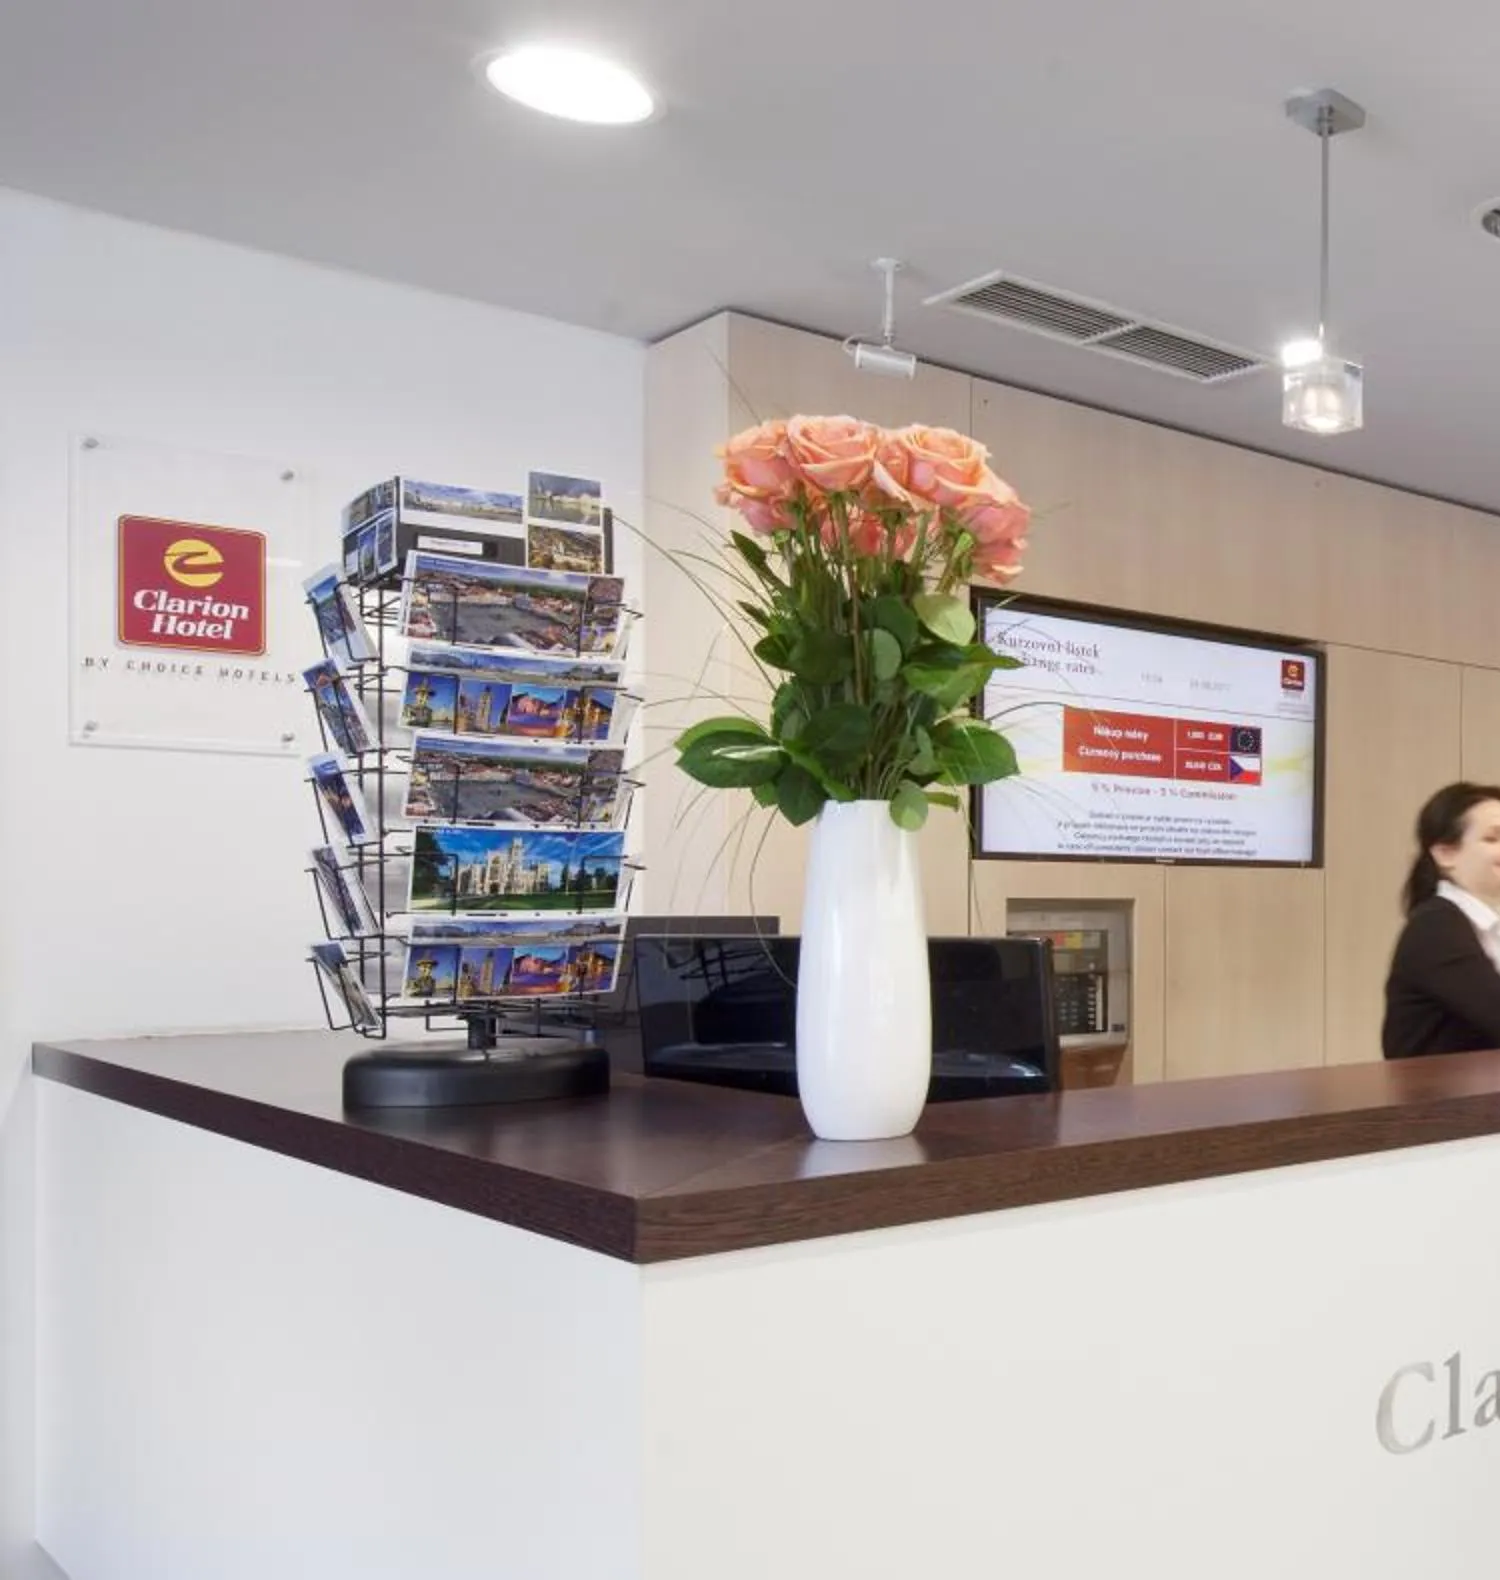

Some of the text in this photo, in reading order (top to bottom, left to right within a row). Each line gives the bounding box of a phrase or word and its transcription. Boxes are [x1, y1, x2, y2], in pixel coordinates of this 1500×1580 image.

[133, 589, 249, 620] Clarion
[150, 613, 234, 640] Hotel
[85, 656, 296, 683] BY CHOICE HOTELS
